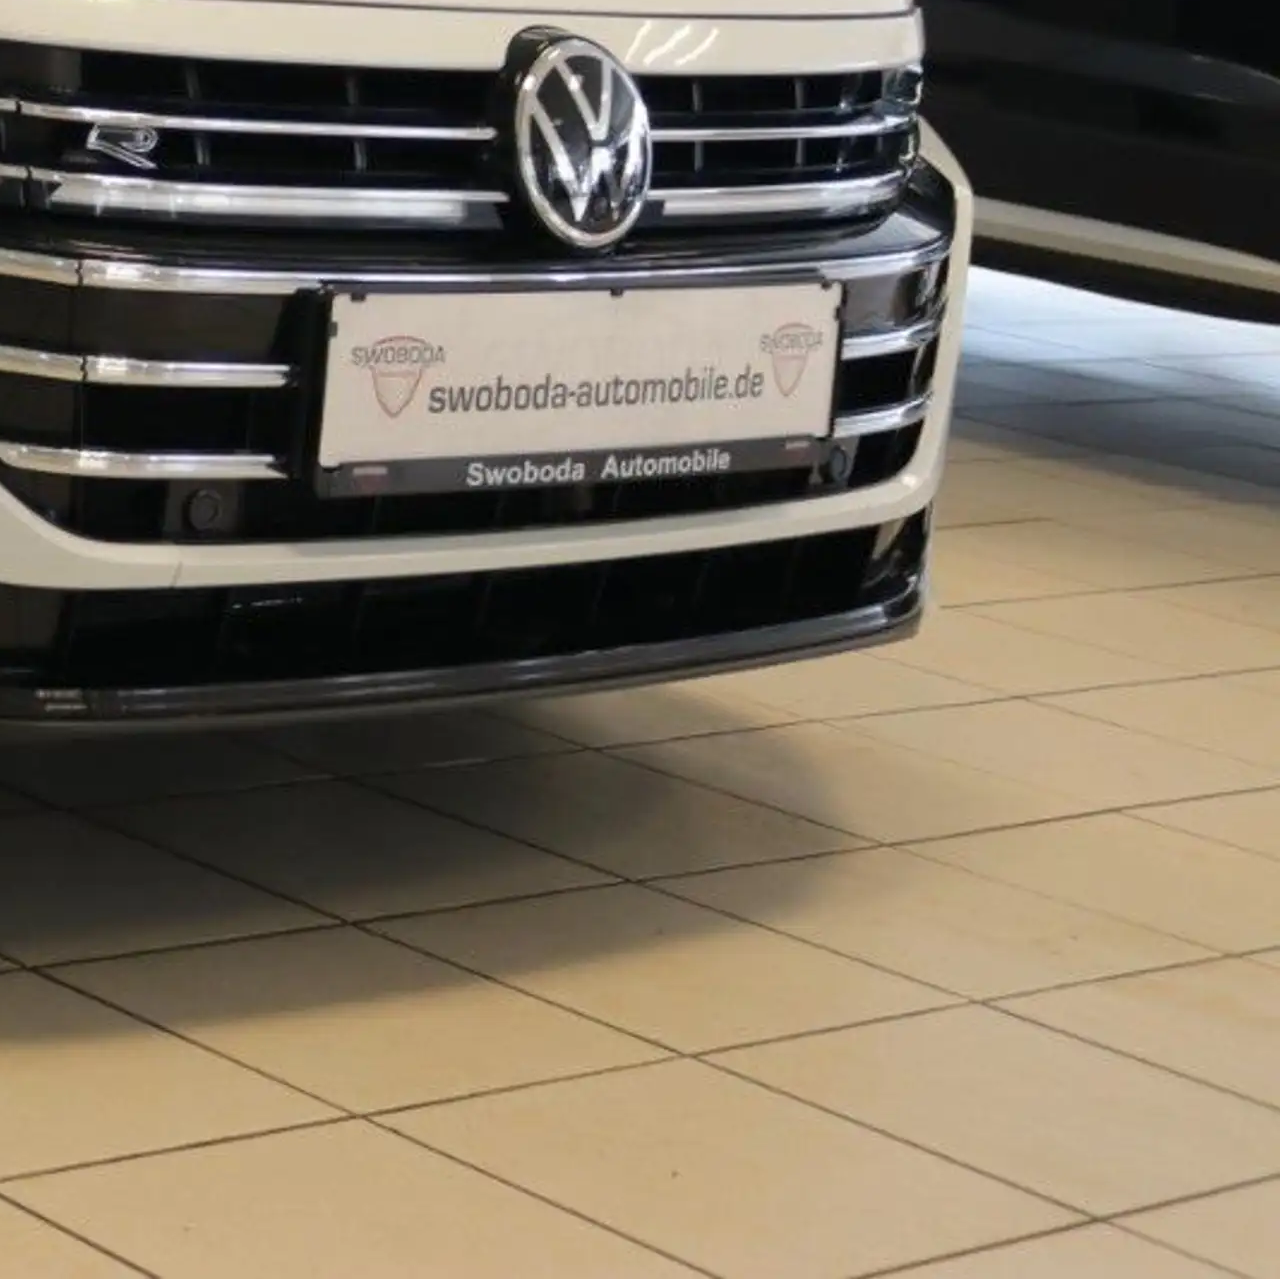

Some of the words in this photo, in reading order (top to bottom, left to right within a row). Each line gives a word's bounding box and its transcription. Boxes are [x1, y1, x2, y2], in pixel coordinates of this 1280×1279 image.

[427, 363, 765, 414] swoboda-automobile.de
[466, 458, 586, 487] Swoboda
[600, 448, 732, 480] Automobile
